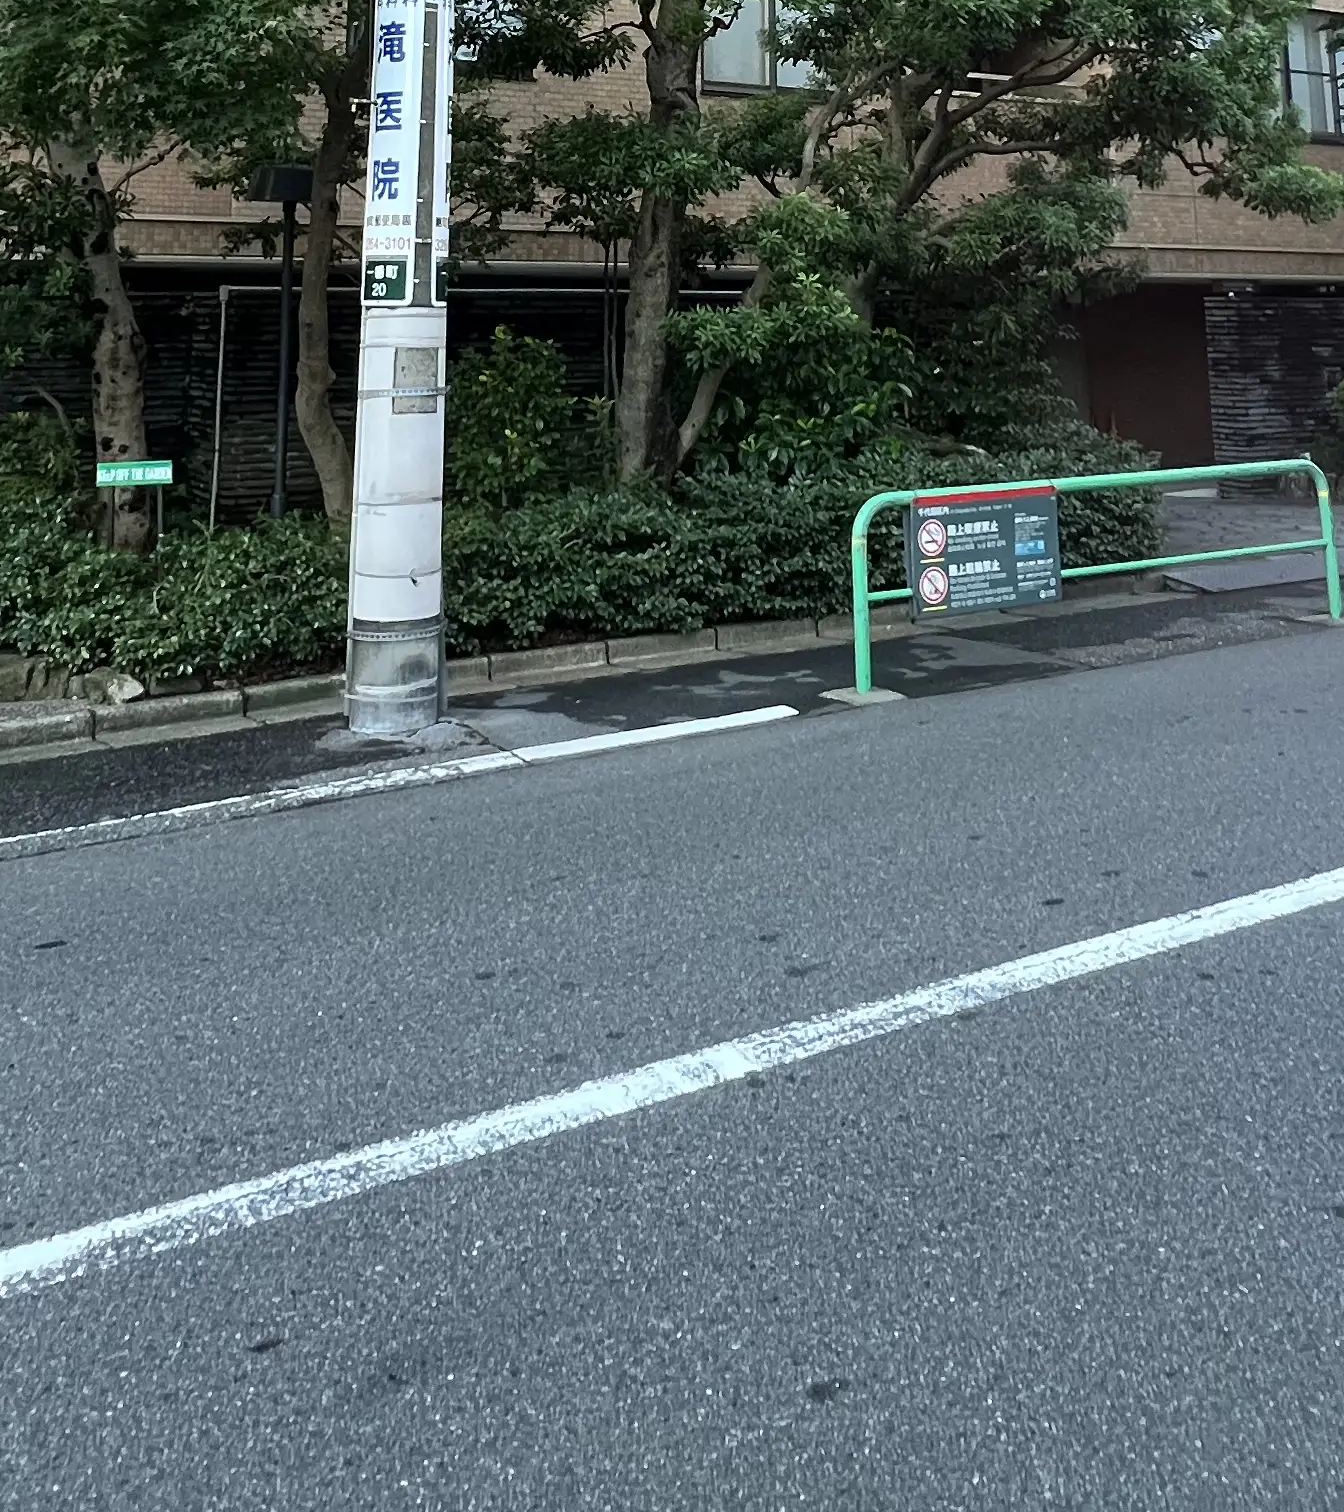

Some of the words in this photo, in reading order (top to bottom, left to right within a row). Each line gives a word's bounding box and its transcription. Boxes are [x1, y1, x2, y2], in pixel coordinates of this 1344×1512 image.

[372, 21, 406, 201] 滝医院
[371, 282, 387, 297] 20
